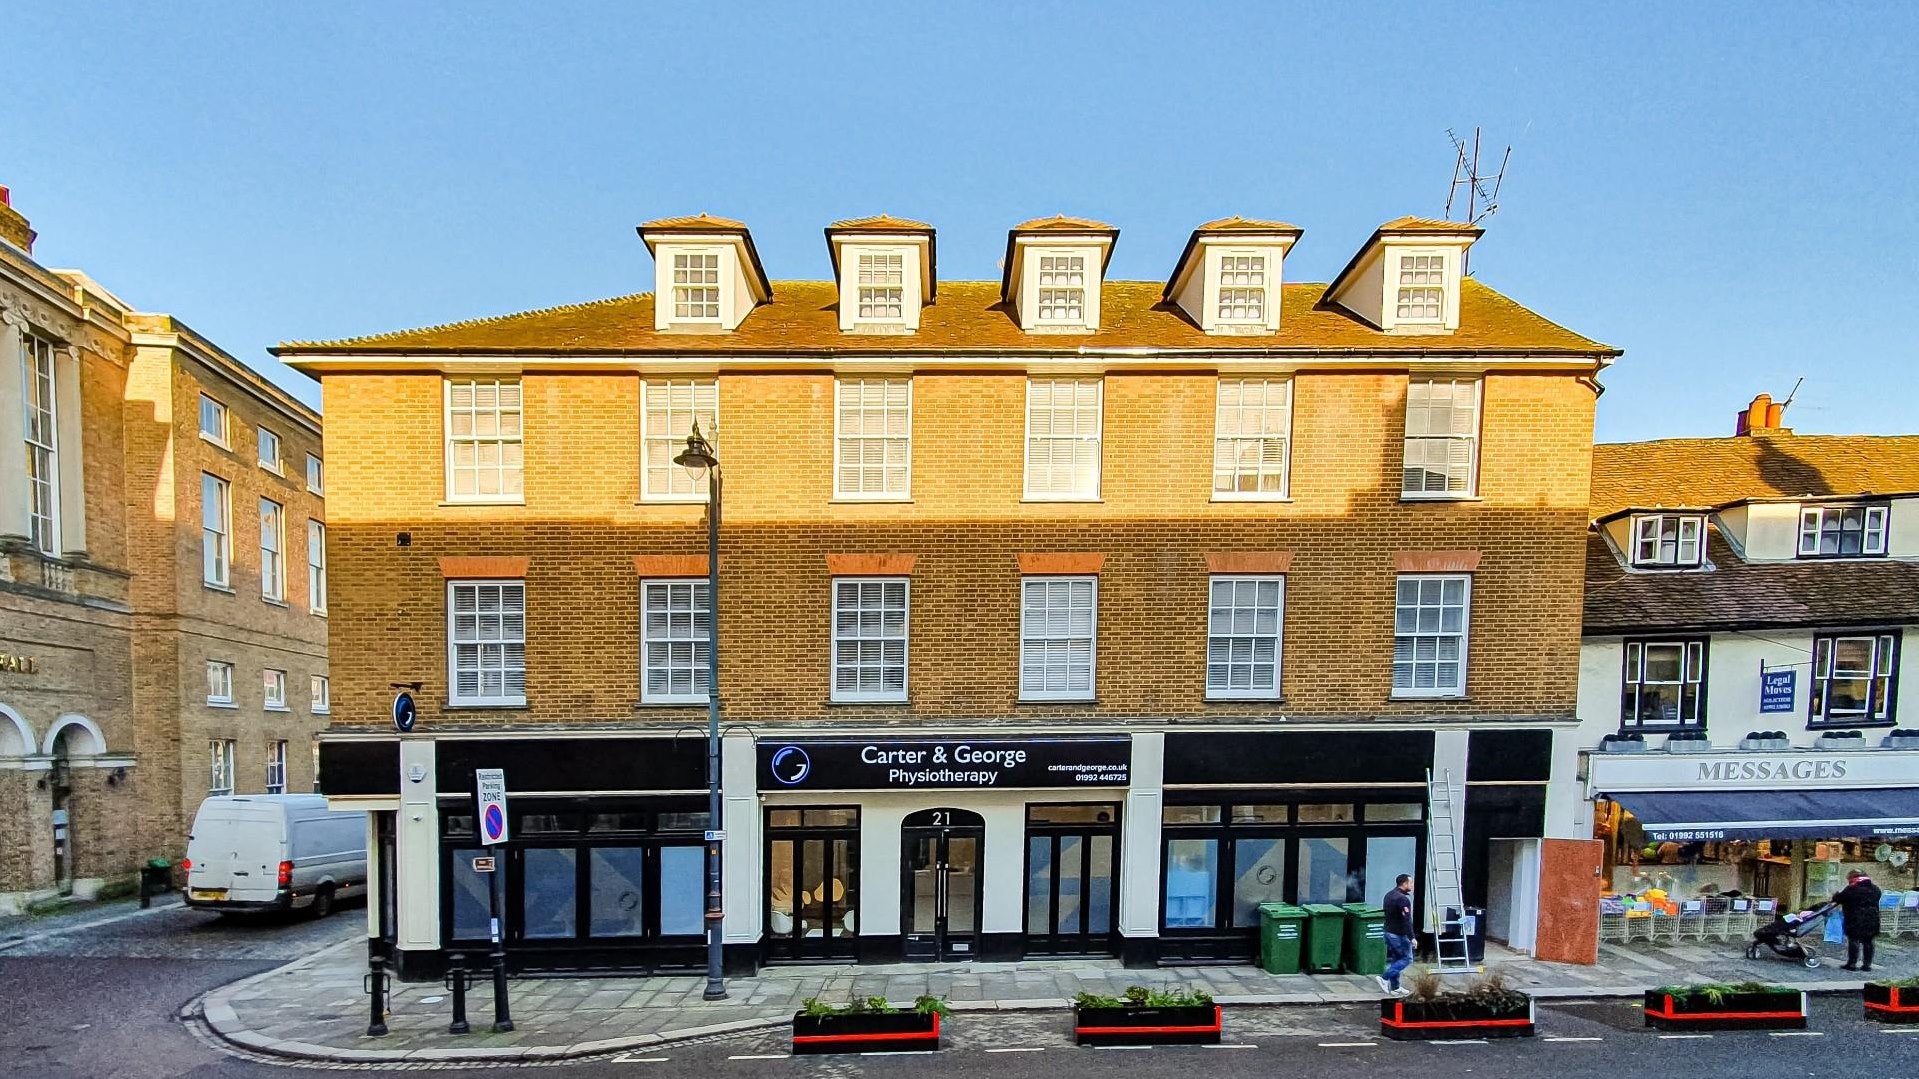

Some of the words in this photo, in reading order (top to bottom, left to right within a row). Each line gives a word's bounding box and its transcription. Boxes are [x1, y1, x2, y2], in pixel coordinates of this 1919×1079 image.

[1767, 674, 1791, 687] Legal
[1764, 686, 1792, 695] Moves
[861, 745, 926, 764] Carter
[932, 746, 948, 764] &
[954, 745, 1027, 767] George
[1047, 764, 1128, 773] carterandgeorge.co.uk
[1697, 760, 1847, 781] MESSAGES
[889, 768, 998, 785] Physiotherapy
[1075, 773, 1098, 781] 01992
[1099, 773, 1127, 781] 446725
[482, 792, 501, 802] ZONE
[932, 811, 950, 825] 21
[1653, 832, 1668, 841] Tel:
[1669, 831, 1693, 840] 01992
